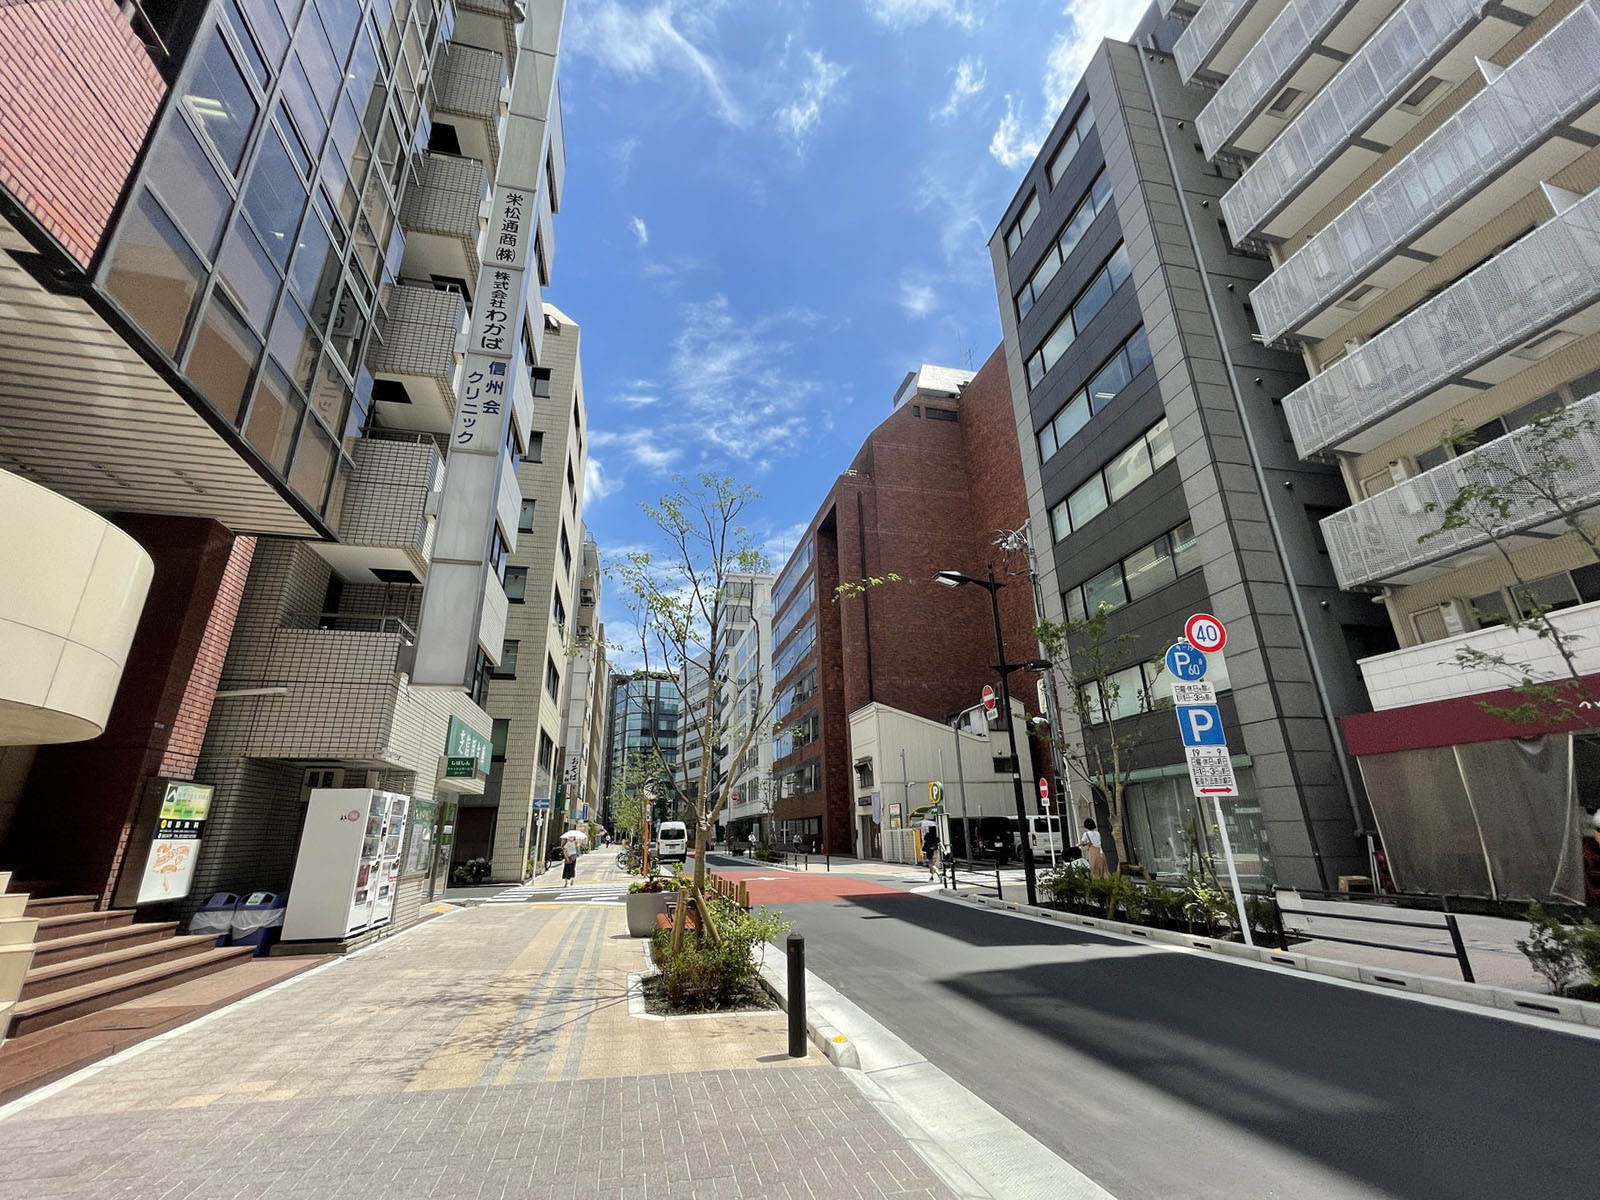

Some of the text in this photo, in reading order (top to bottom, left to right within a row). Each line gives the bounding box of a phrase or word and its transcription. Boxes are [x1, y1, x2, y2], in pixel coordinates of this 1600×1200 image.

[481, 271, 510, 350] 株式会社わかば
[482, 361, 505, 415] 信州会
[457, 371, 484, 445] クリニック
[1197, 625, 1217, 641] 40
[1174, 652, 1200, 676] P 60
[1188, 709, 1214, 742] P
[1191, 749, 1200, 757] 19
[570, 757, 579, 781] おそば
